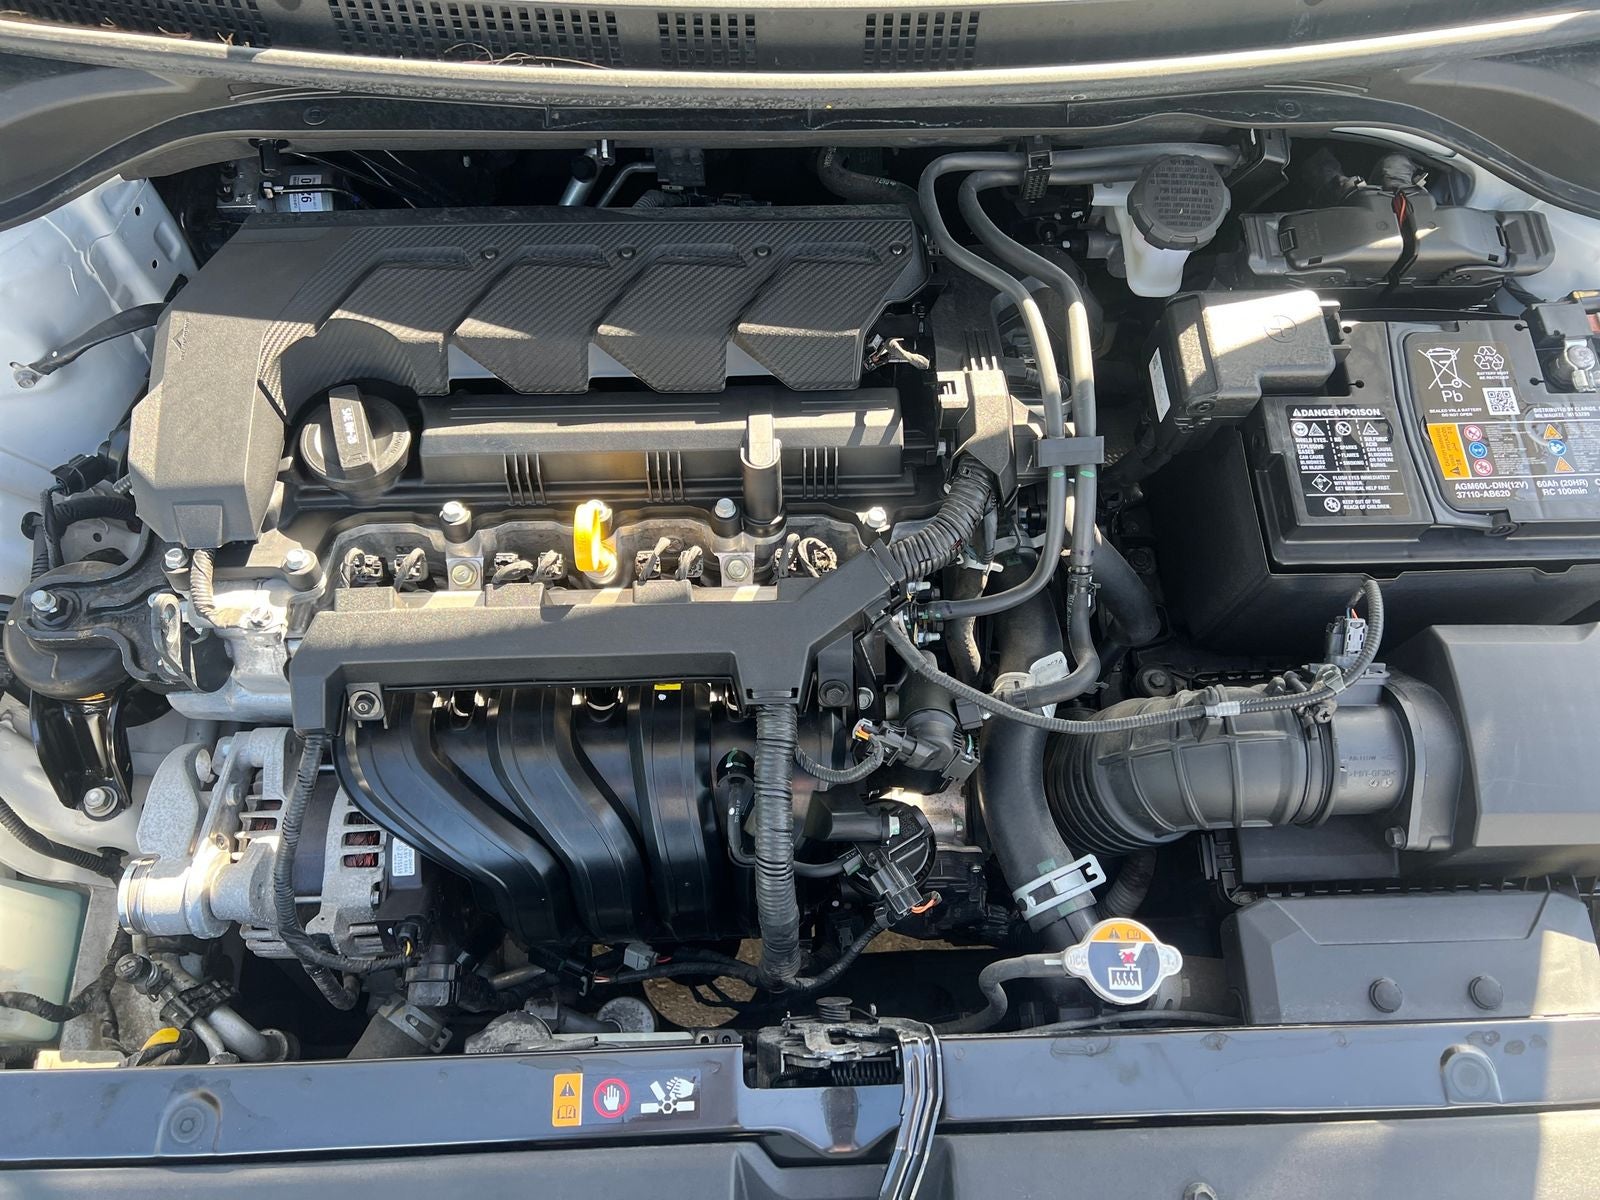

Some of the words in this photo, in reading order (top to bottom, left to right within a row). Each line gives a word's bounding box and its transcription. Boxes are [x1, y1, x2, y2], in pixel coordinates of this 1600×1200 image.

[1441, 389, 1464, 402] Pb
[1560, 479, 1589, 487] (20HR)
[1557, 487, 1588, 495] 100min
